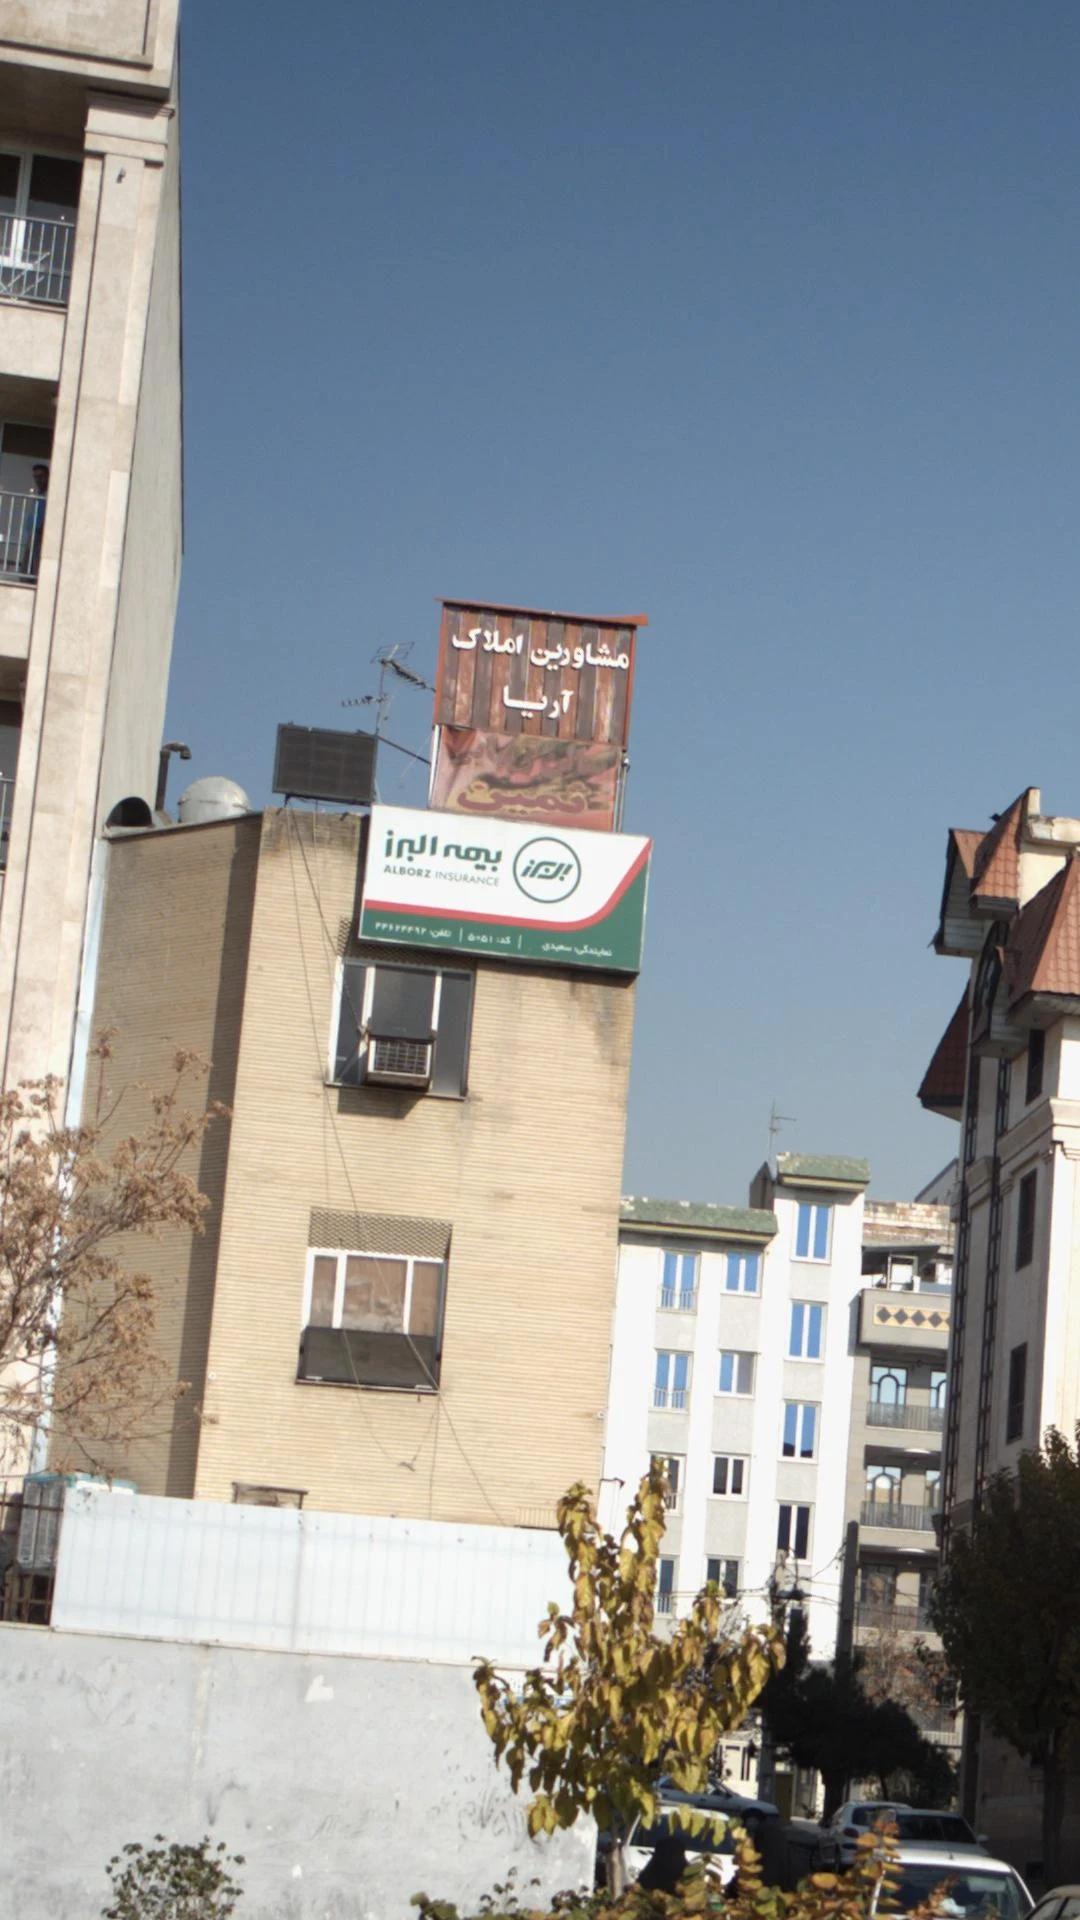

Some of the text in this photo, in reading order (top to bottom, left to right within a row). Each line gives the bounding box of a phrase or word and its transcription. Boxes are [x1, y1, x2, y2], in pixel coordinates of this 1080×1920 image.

[452, 628, 630, 671] مشاورین املاک
[385, 829, 502, 872] بیمه البرز
[384, 864, 500, 887] ALBORZ INSURANCE
